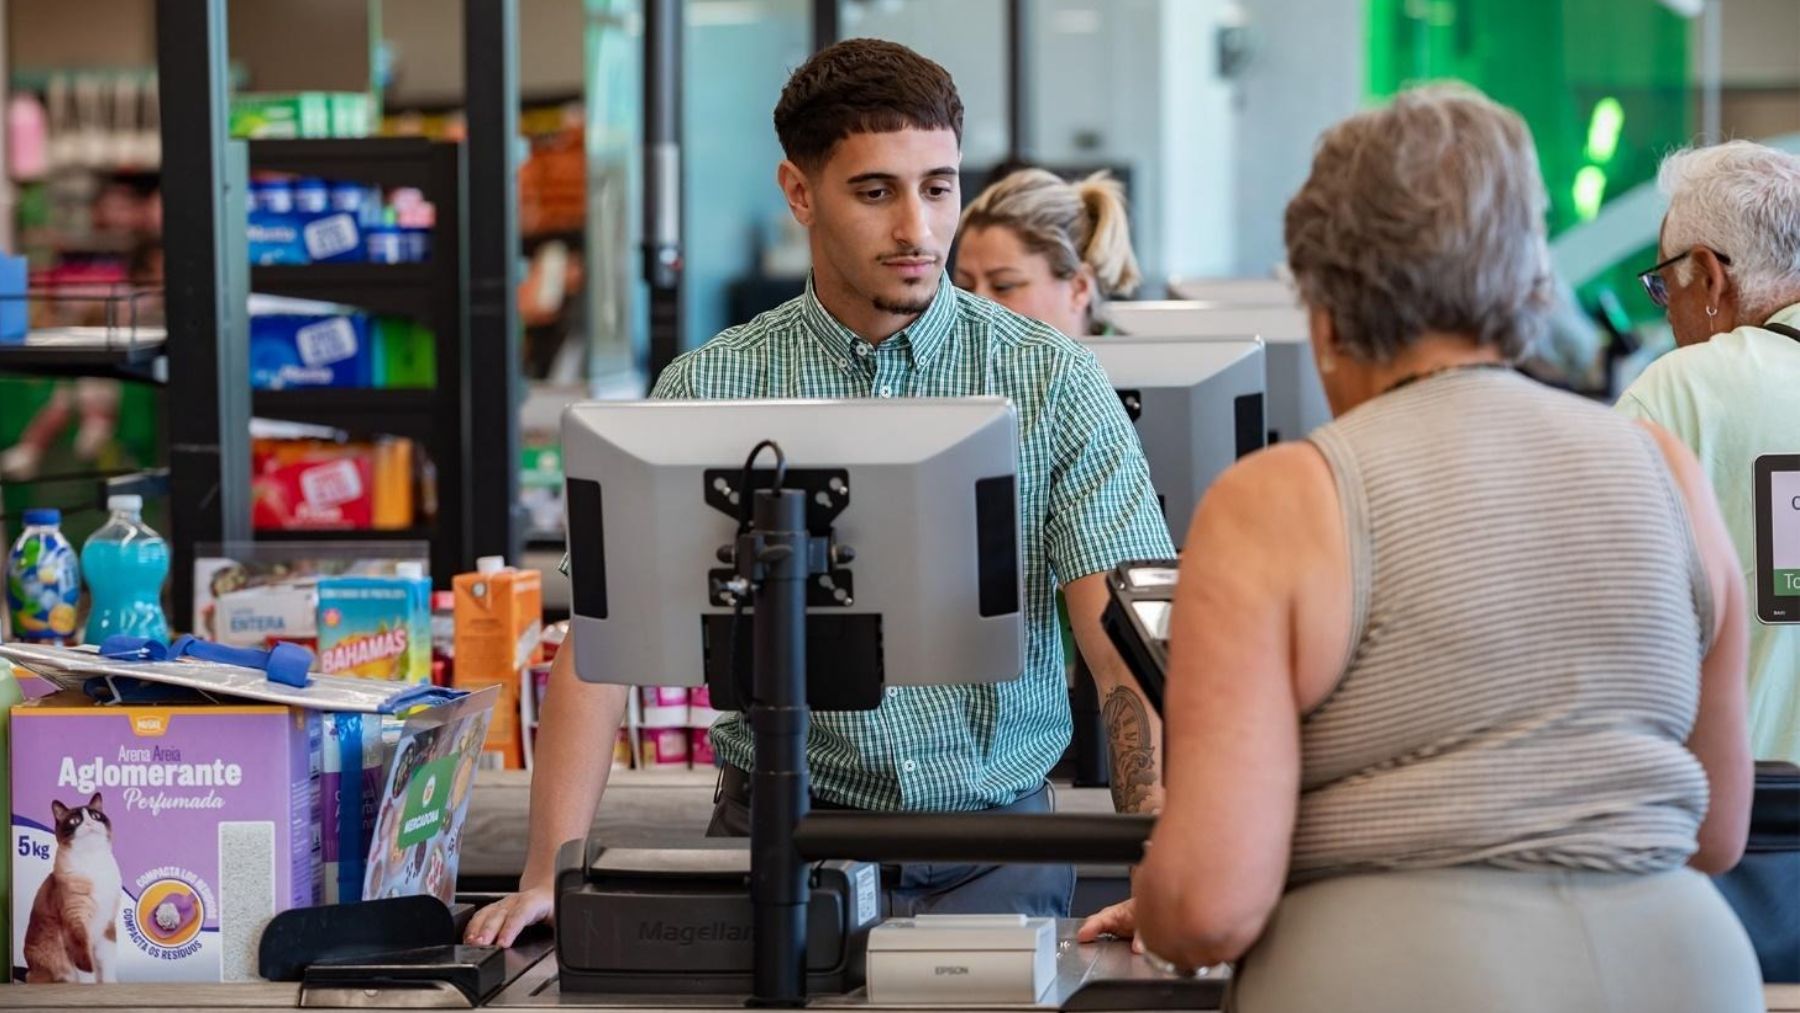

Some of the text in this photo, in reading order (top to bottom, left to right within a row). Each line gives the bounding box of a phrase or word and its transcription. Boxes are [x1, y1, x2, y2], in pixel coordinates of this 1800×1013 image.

[322, 627, 407, 675] BAHAMAS
[118, 745, 181, 762] Arena Areia
[58, 756, 242, 794] Aglomerante
[123, 787, 225, 816] Perfumada
[123, 907, 148, 951] COMPACTA
[148, 947, 160, 958] OS
[935, 966, 969, 975] EPSON
